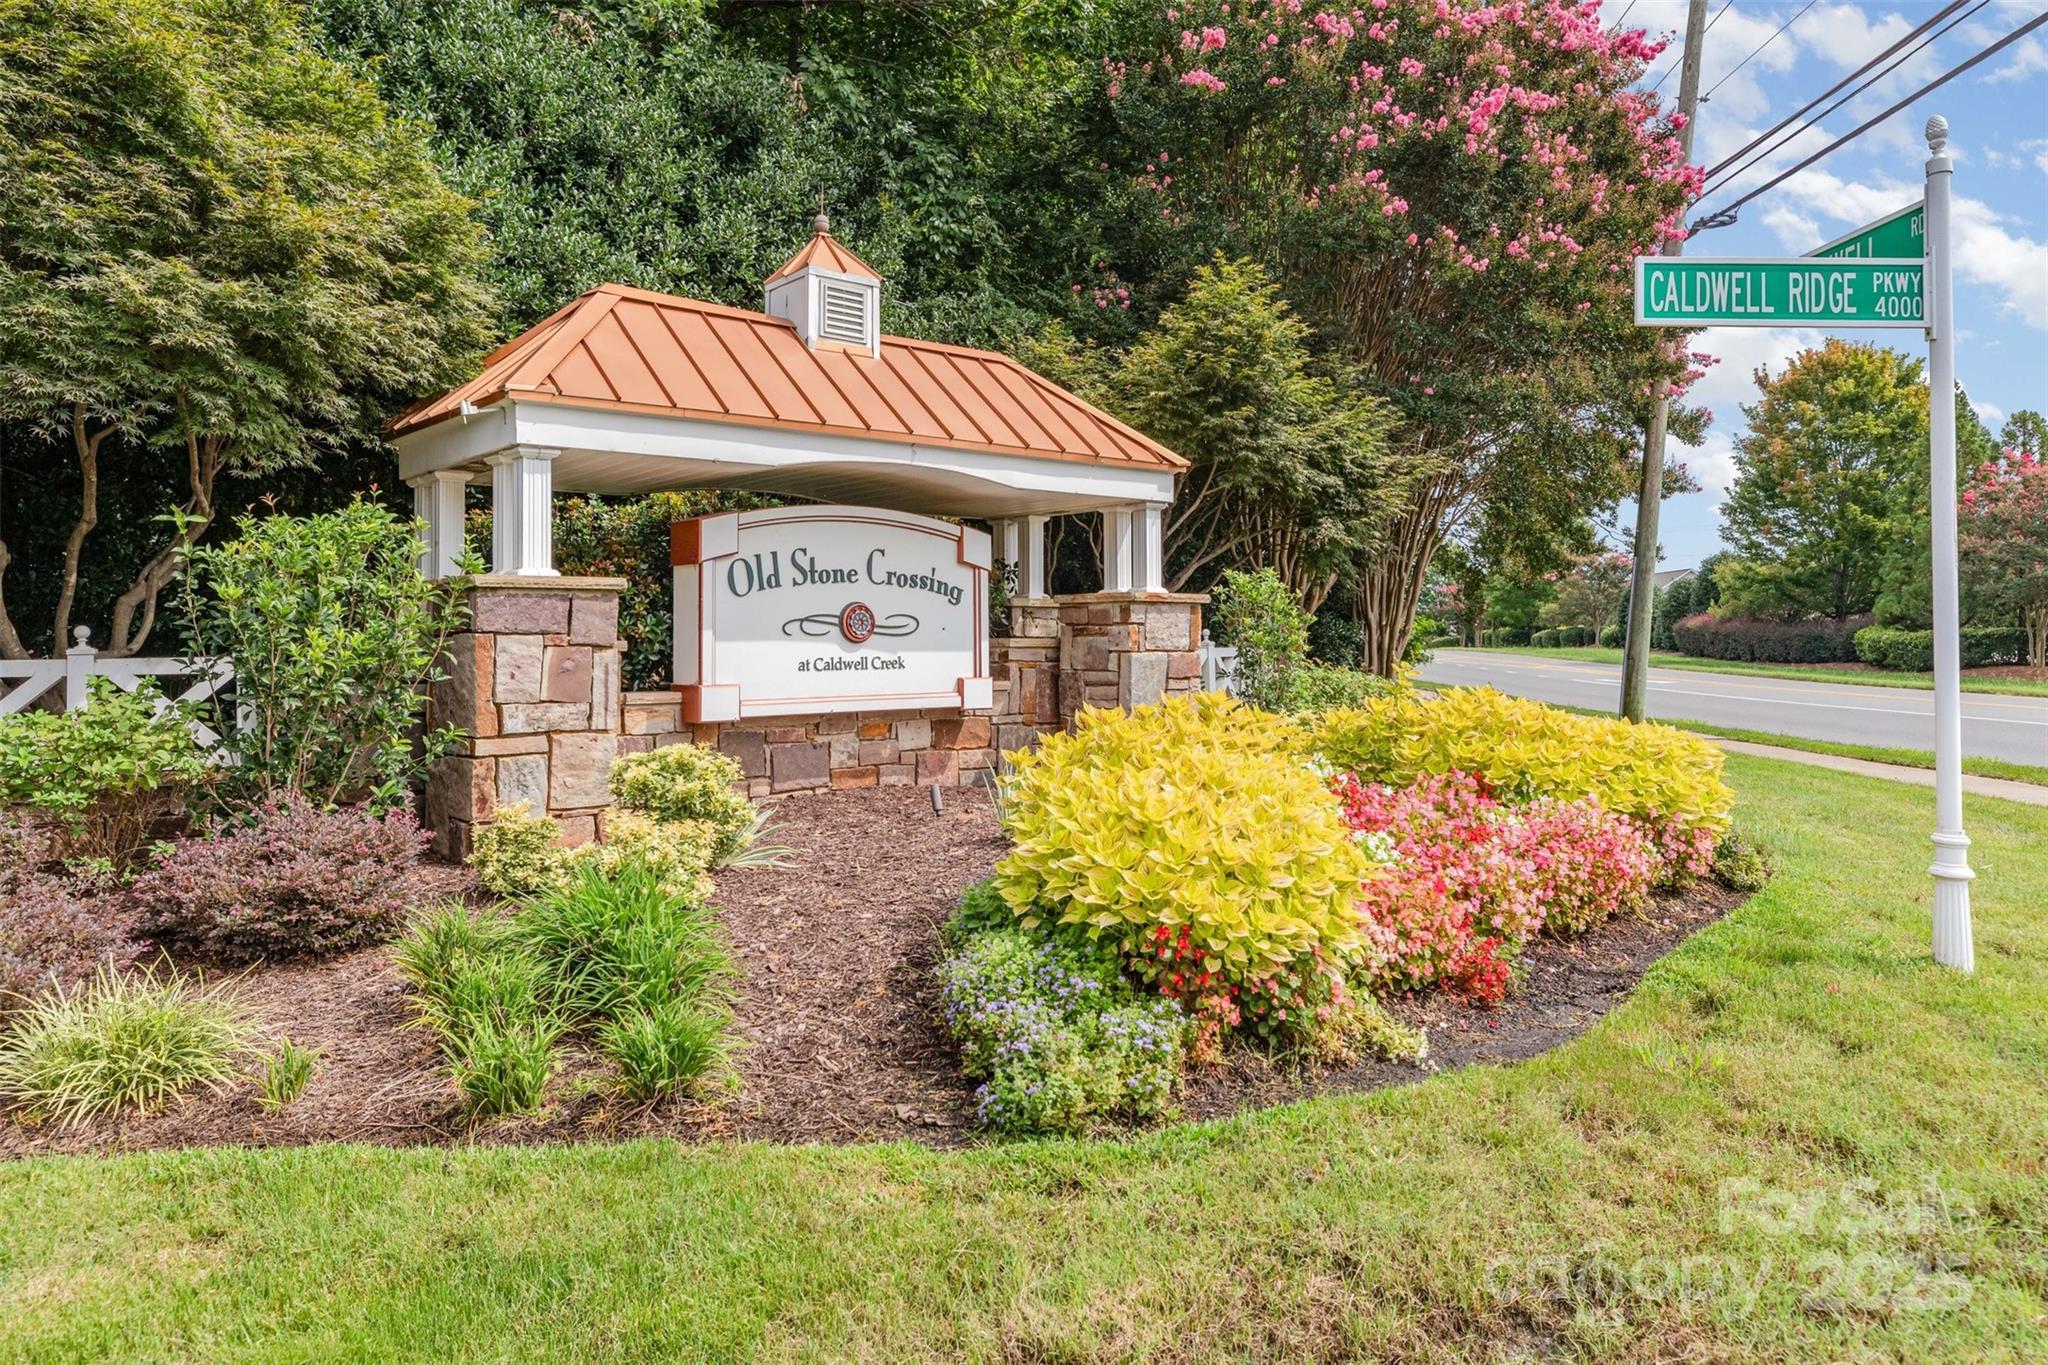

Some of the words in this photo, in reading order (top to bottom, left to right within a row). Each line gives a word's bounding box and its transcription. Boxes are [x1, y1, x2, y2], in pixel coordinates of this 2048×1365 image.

[1650, 270, 1775, 313] CALDWELL
[1788, 272, 1857, 313] RIDGE
[1873, 271, 1922, 293] PKWY
[1874, 296, 1922, 318] 4000
[727, 551, 782, 597] Old
[791, 547, 859, 587] Stone
[866, 548, 964, 605] Crossing
[797, 659, 811, 672] at
[813, 656, 869, 672] Caldwell
[871, 655, 906, 671] Creek
